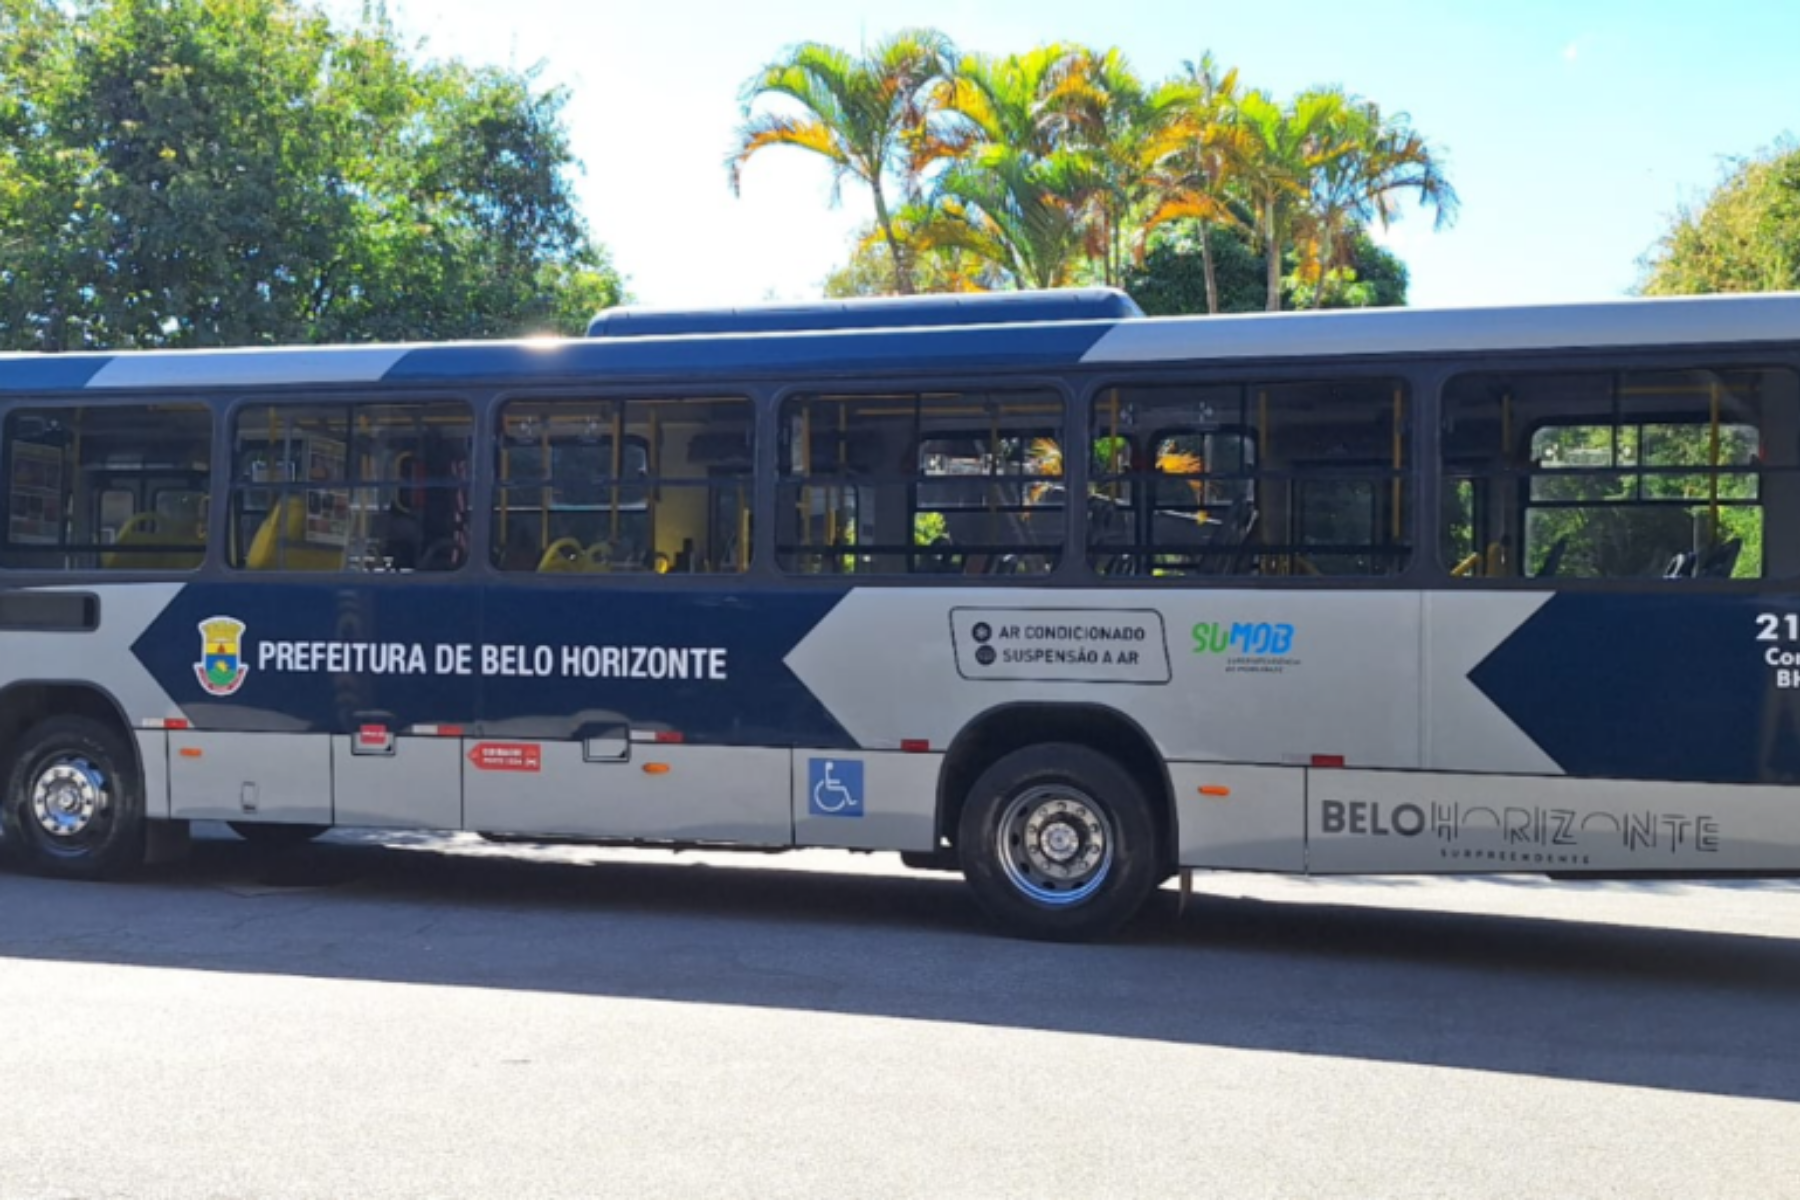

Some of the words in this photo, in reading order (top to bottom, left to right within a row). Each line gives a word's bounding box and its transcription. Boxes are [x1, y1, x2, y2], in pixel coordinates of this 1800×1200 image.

[999, 626, 1021, 640] AR
[1025, 626, 1145, 641] CONDICIONADO
[1191, 621, 1296, 655] SUMOB
[1755, 612, 1798, 641] 21
[258, 641, 427, 674] PREFEITURA
[435, 644, 473, 675] DE
[481, 644, 553, 676] BELO
[560, 645, 728, 680] HORIZONTE
[1002, 646, 1098, 664] SUSPENSÃO
[1102, 651, 1112, 664] A
[1116, 651, 1139, 665] AR
